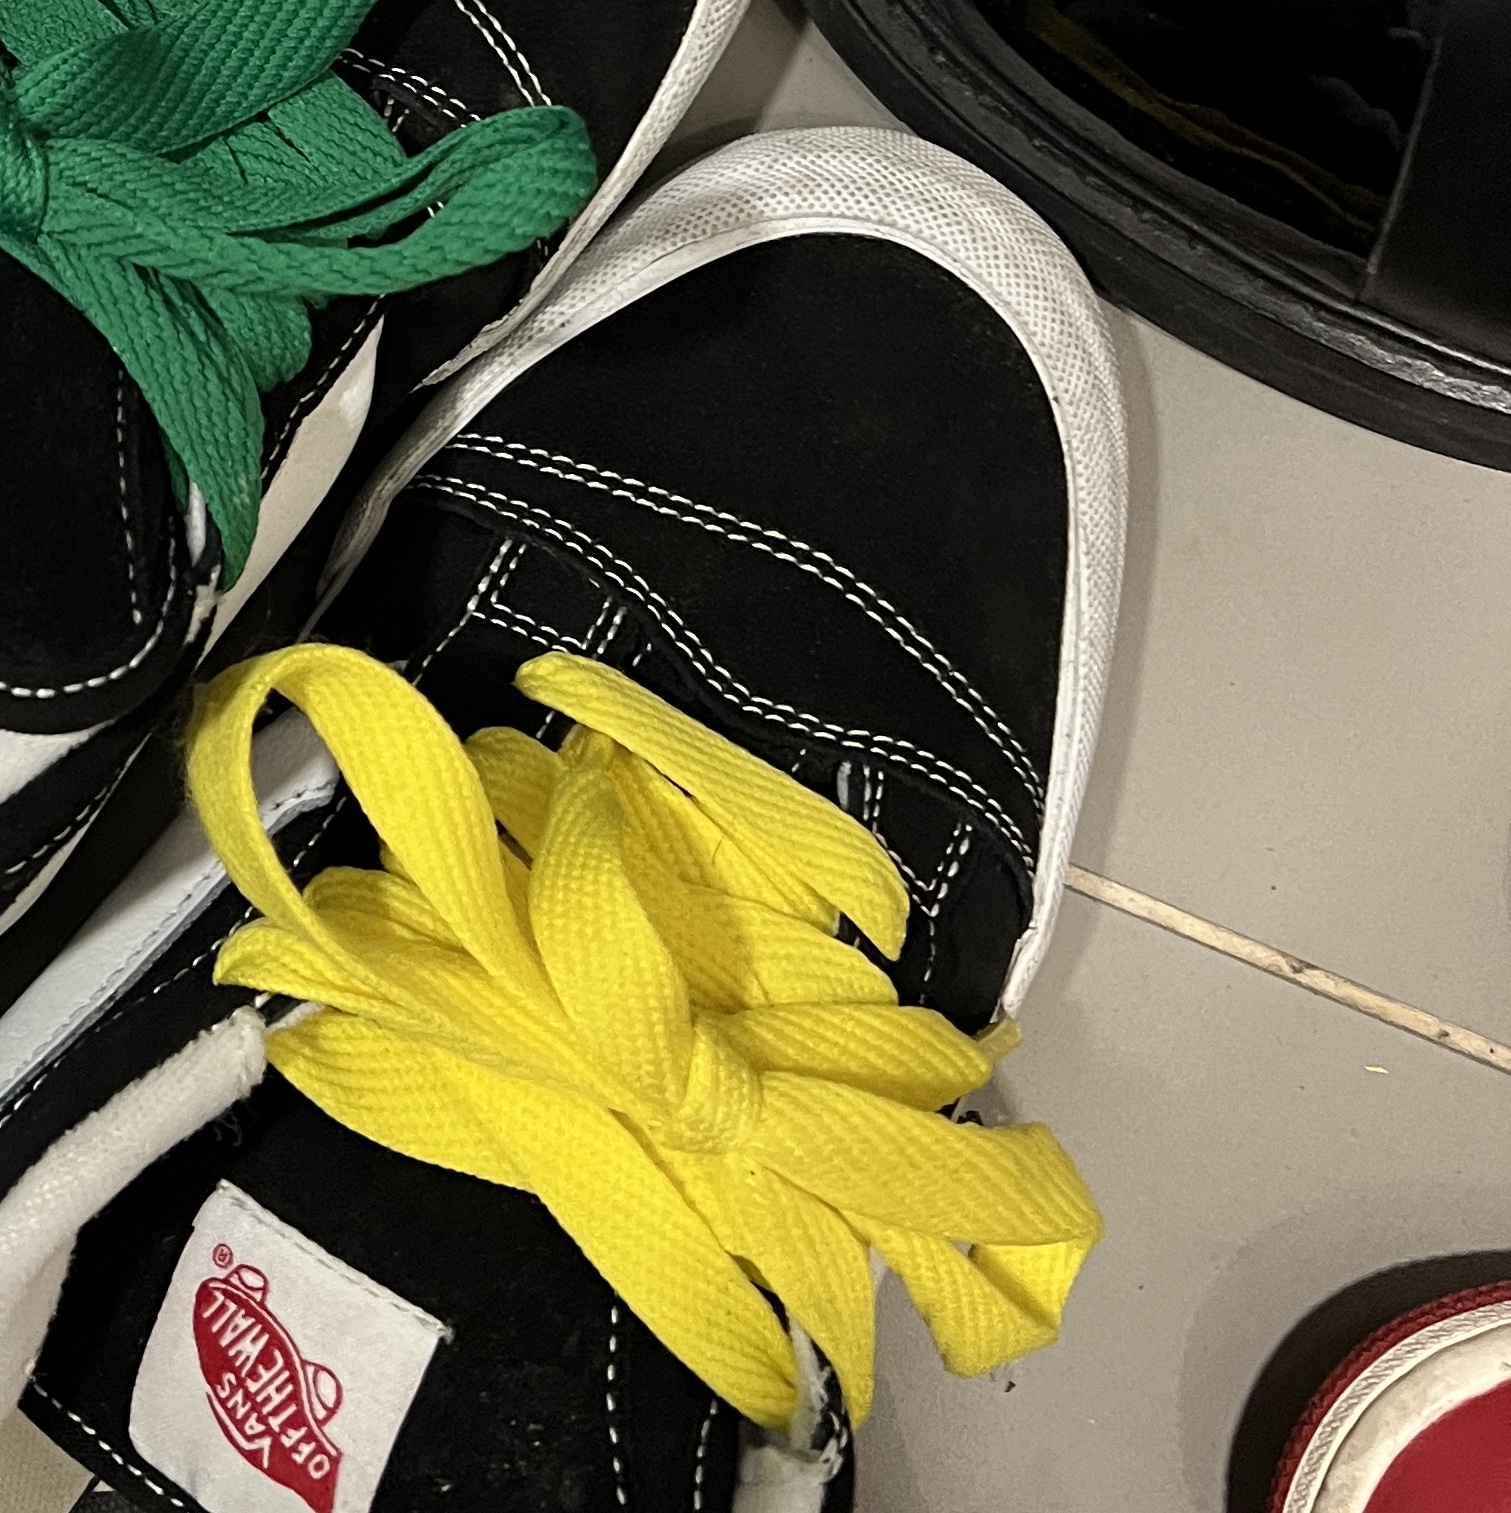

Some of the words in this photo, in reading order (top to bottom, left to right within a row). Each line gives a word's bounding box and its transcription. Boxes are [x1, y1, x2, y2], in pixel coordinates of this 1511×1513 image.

[202, 1290, 269, 1376] WALL
[208, 1372, 271, 1469] VANS
[245, 1348, 297, 1432] THE
[280, 1426, 331, 1480] OFF
